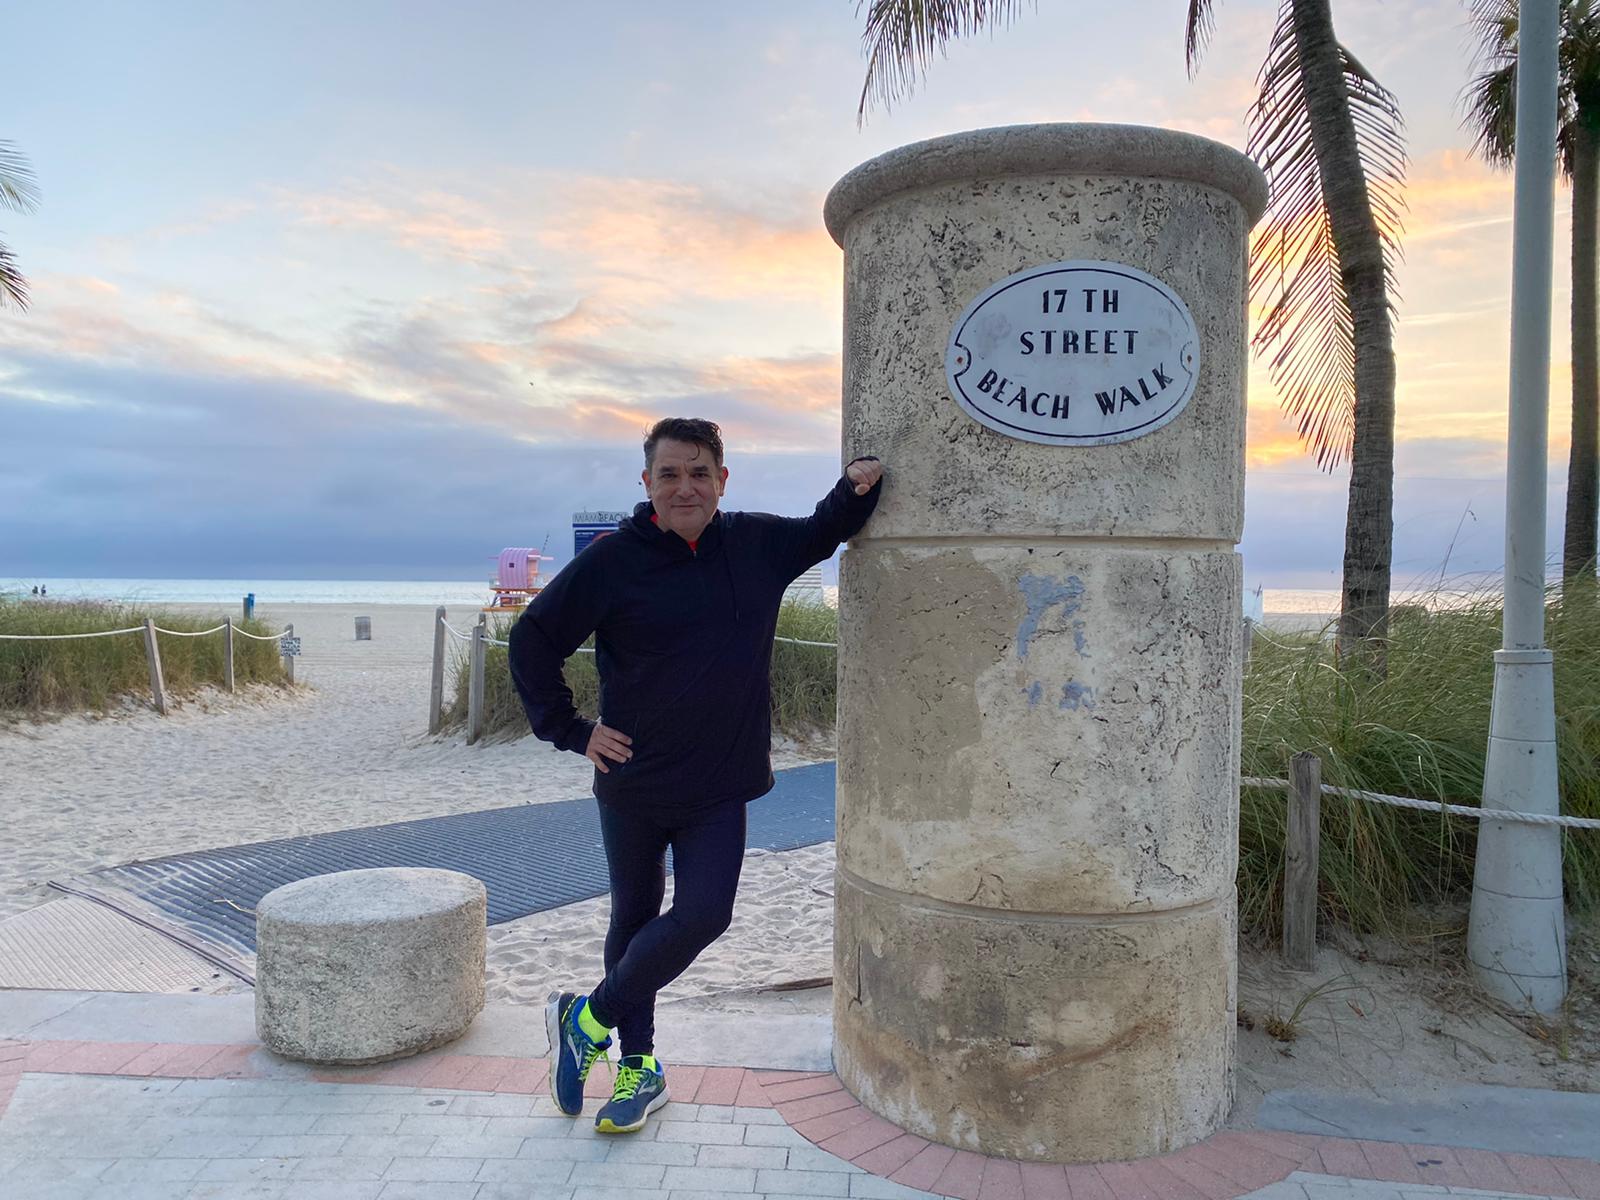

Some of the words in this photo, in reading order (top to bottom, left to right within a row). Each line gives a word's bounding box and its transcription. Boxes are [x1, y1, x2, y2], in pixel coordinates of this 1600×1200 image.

[1042, 290, 1068, 313] 17
[1083, 289, 1119, 313] TH
[1020, 330, 1139, 355] STREET
[976, 369, 1070, 420] BEACH
[1094, 362, 1174, 416] WALK
